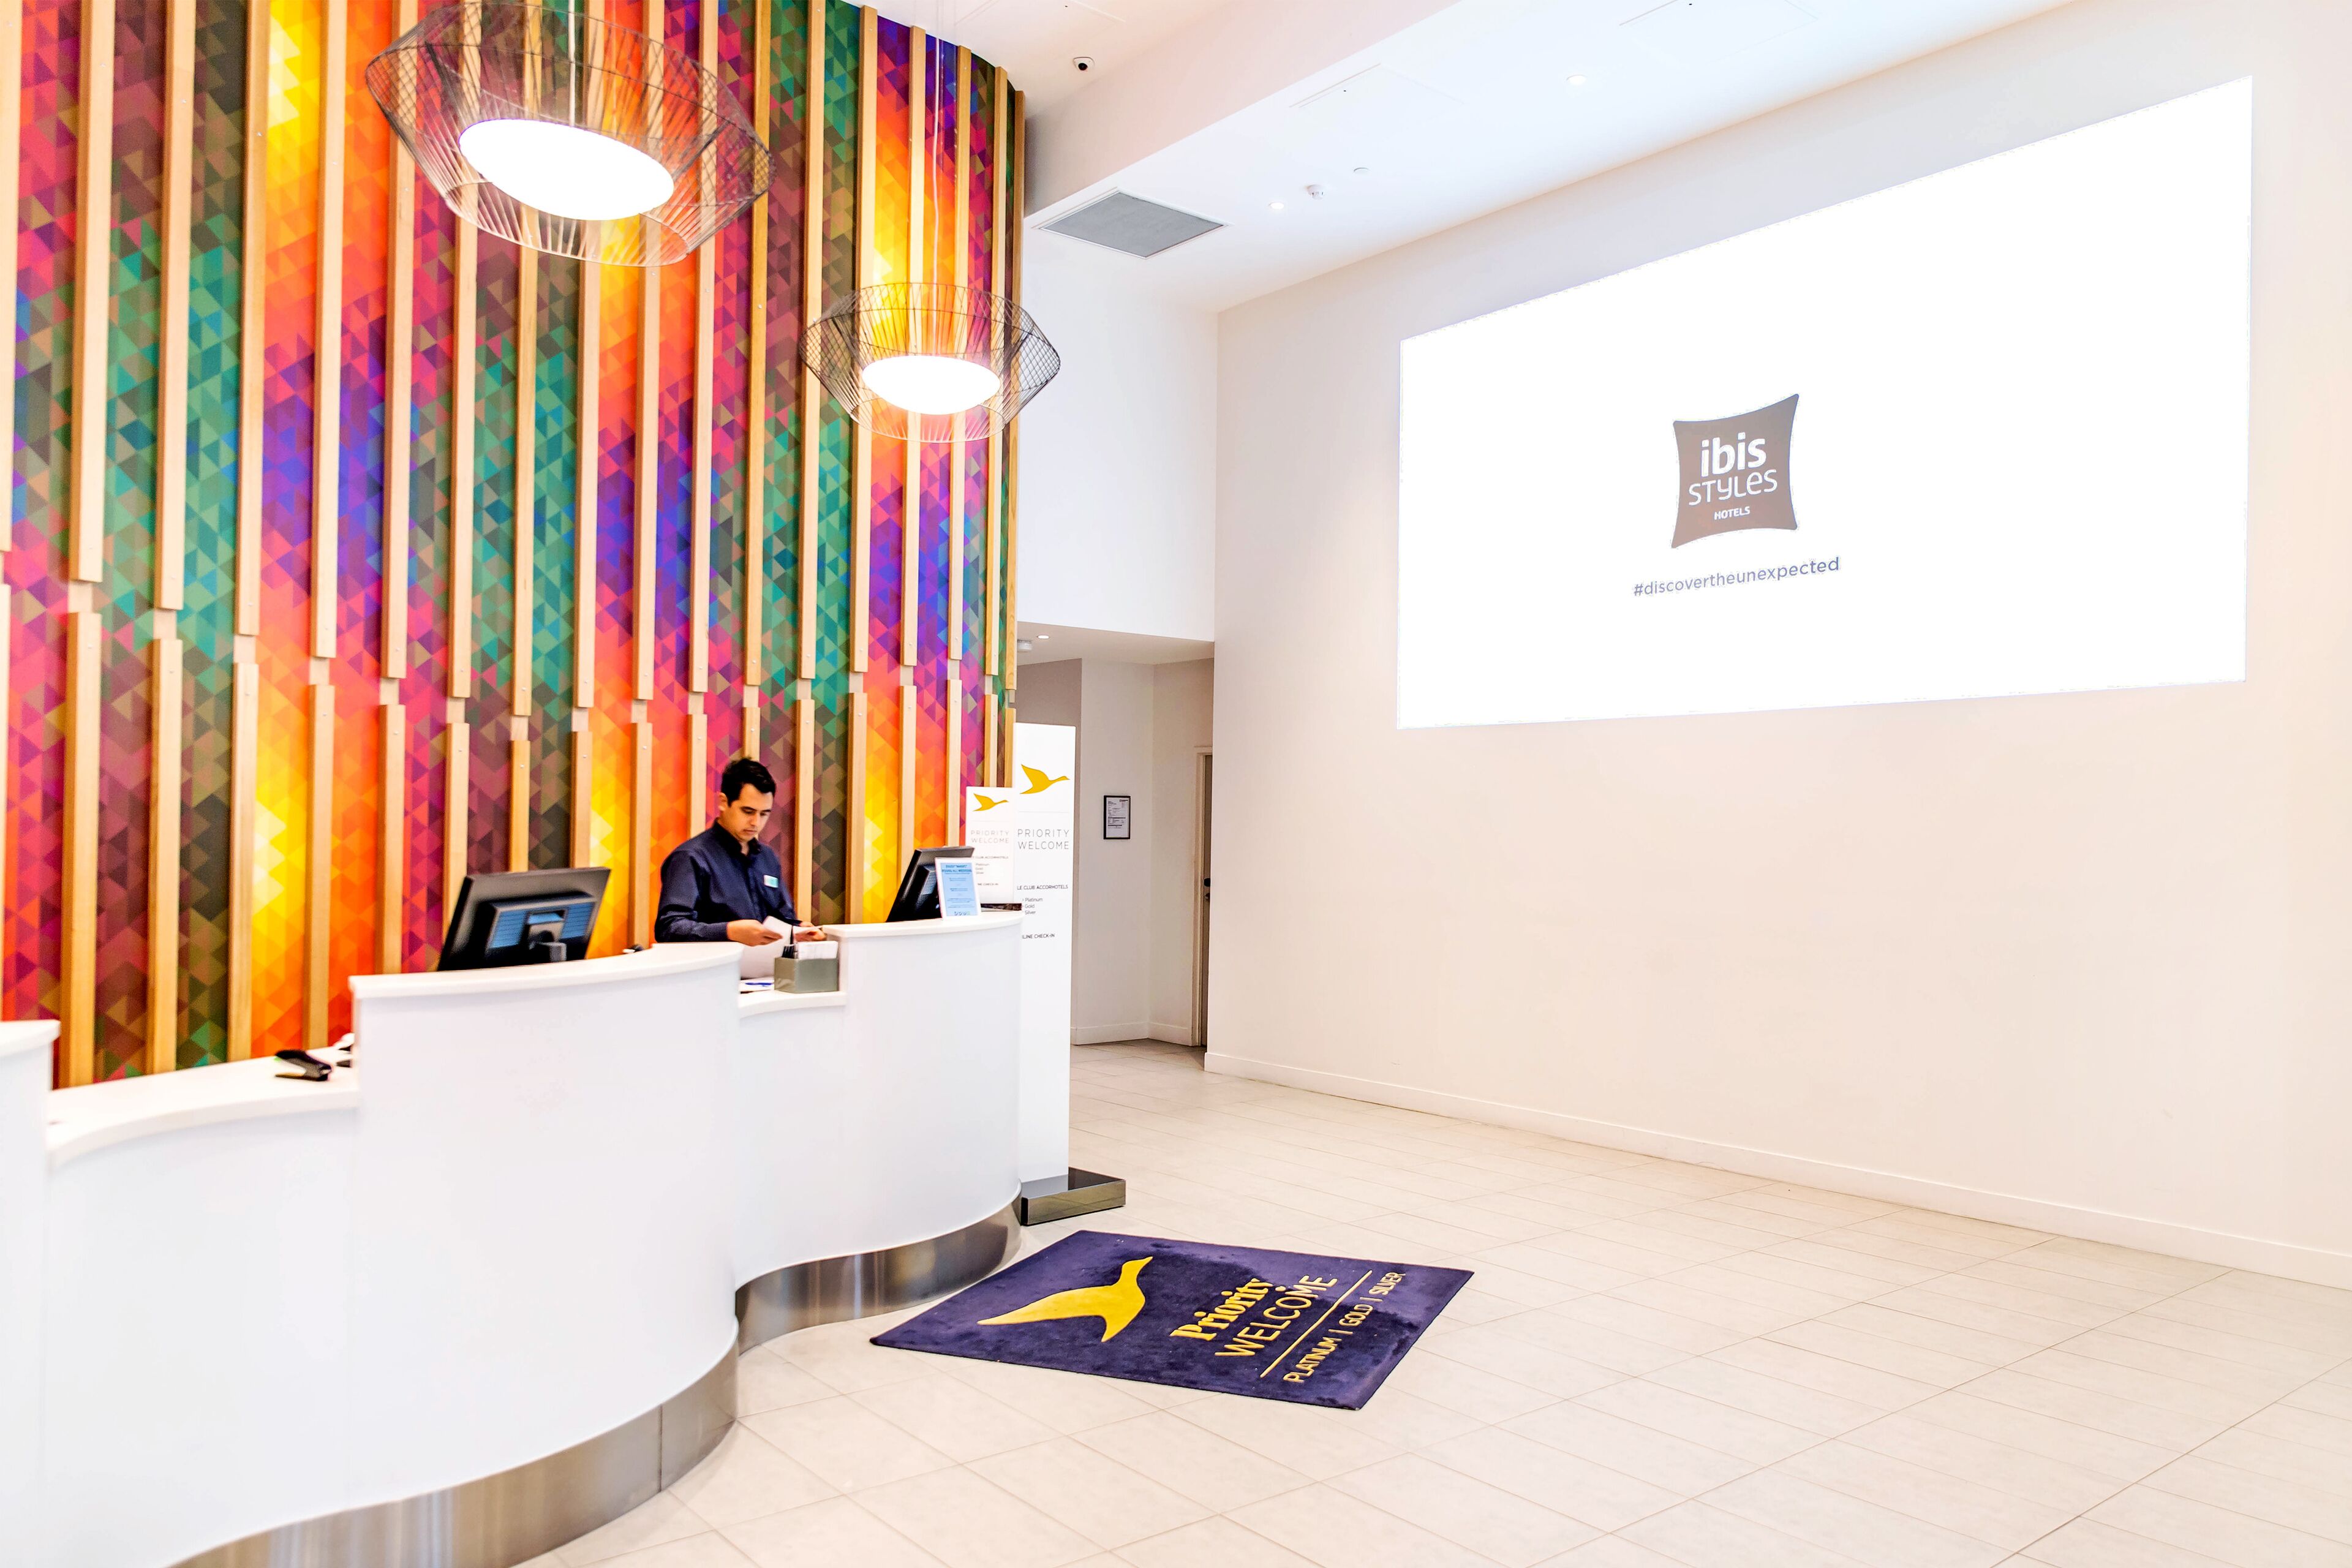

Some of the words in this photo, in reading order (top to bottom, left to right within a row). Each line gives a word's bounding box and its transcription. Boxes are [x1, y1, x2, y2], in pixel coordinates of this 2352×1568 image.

[1700, 432, 1767, 477] ibis
[1714, 506, 1751, 520] HOTELS
[1634, 557, 1841, 597] #discovertheunexpected
[1017, 829, 1069, 837] PRIORITY
[1017, 841, 1069, 850] WELCOME
[1169, 1278, 1273, 1341] Priority
[1215, 1275, 1338, 1356] WELCOME
[1283, 1336, 1343, 1383] PLATINUM
[1338, 1303, 1374, 1327] GOLD
[1368, 1272, 1406, 1295] SILVER
